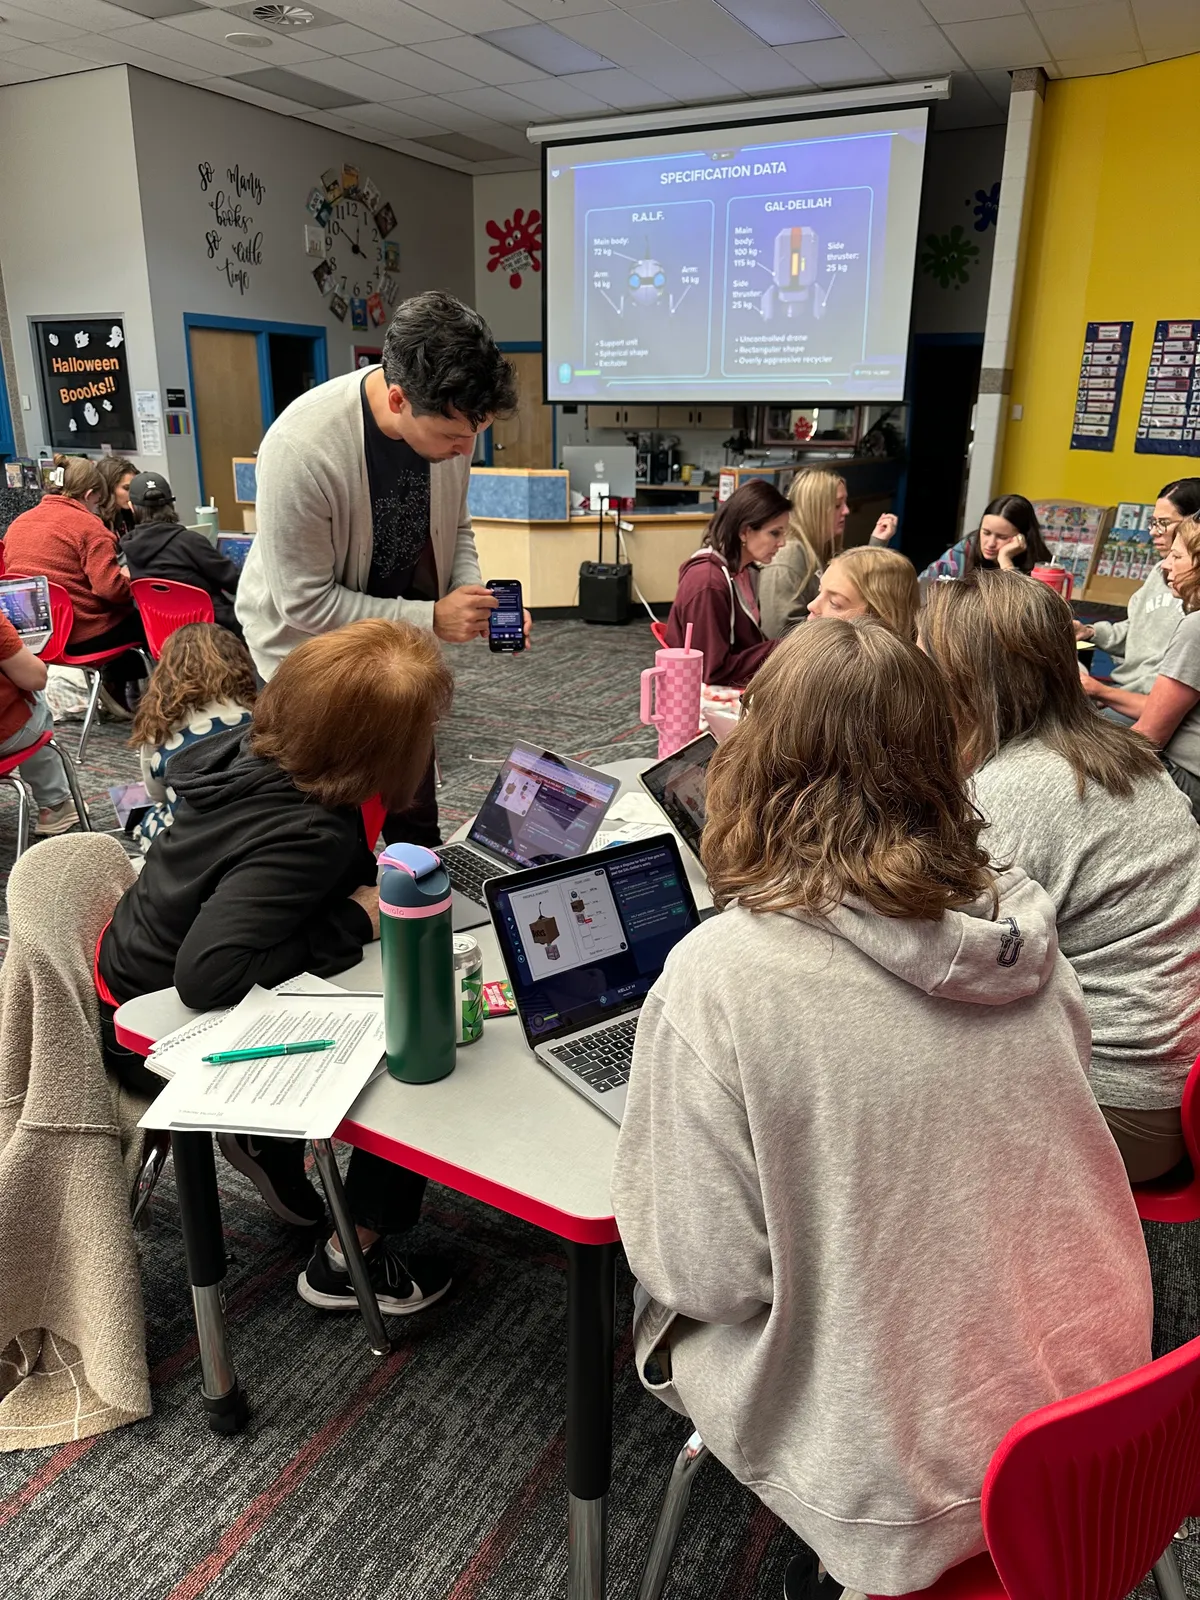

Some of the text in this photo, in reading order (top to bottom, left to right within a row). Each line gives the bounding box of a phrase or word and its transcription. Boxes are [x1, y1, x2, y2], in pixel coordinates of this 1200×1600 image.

[660, 162, 787, 184] SPECIFICATION DATA
[198, 162, 266, 205] so many
[764, 198, 832, 212] GAL-DELILAH
[208, 190, 253, 234] books
[632, 211, 664, 222] R.A.L.F.
[734, 226, 752, 234] Main
[611, 237, 629, 246] body:
[734, 237, 754, 246] body:
[206, 230, 263, 265] so little
[604, 248, 612, 256] kg
[748, 248, 758, 256] kg
[827, 252, 859, 260] thruster:
[746, 260, 756, 268] kg
[826, 264, 848, 272] 25 kg
[216, 258, 250, 296] time
[690, 276, 700, 284] kg
[733, 290, 762, 298] thruster:
[744, 301, 753, 310] kg
[740, 335, 785, 343] Uncontrolled
[600, 340, 624, 348] Support
[600, 348, 648, 358] Spherical shape
[739, 346, 805, 354] Rectangular shape
[52, 357, 119, 372] Halloween
[739, 356, 832, 365] Overly aggressive recycler
[60, 376, 116, 404] Boooks!!
[618, 986, 630, 994] KELLY
